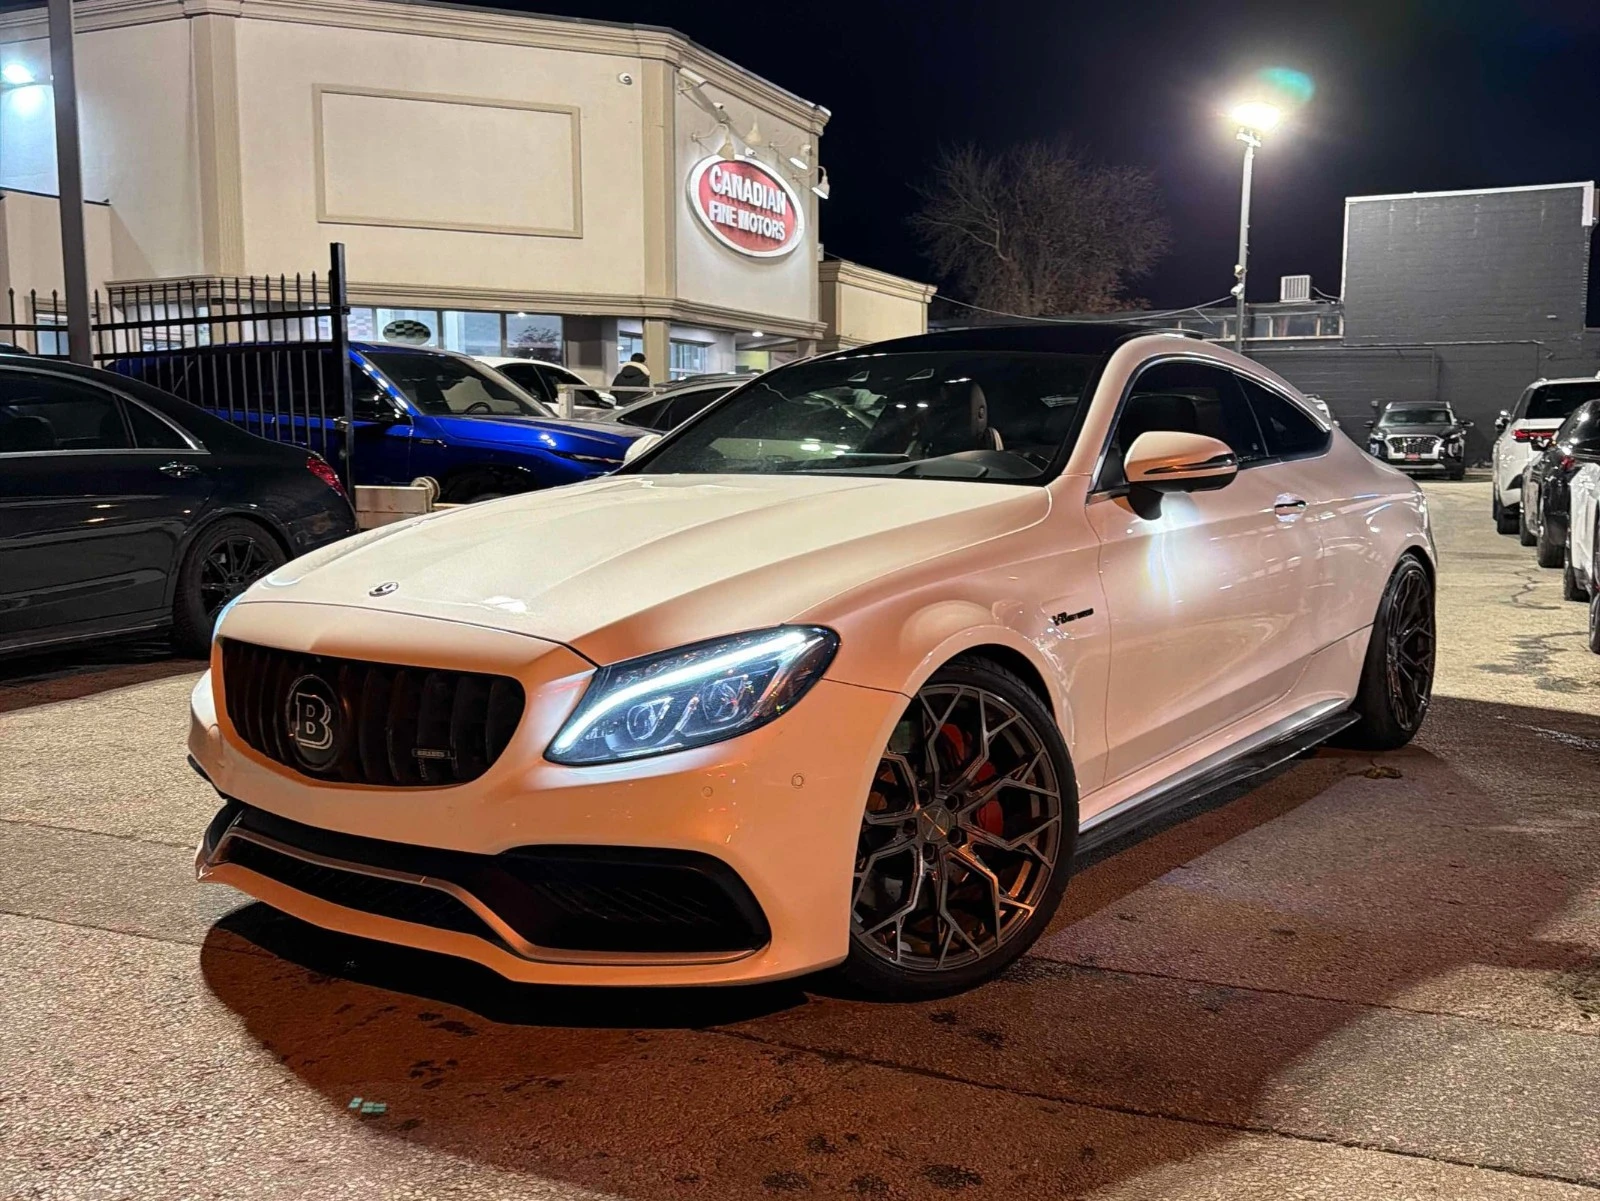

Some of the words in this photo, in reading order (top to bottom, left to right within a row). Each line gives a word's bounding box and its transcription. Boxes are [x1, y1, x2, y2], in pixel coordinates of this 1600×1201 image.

[709, 164, 786, 215] CANADIAN
[709, 200, 738, 227] FINE
[737, 209, 786, 241] MOTORS
[295, 692, 333, 750] B
